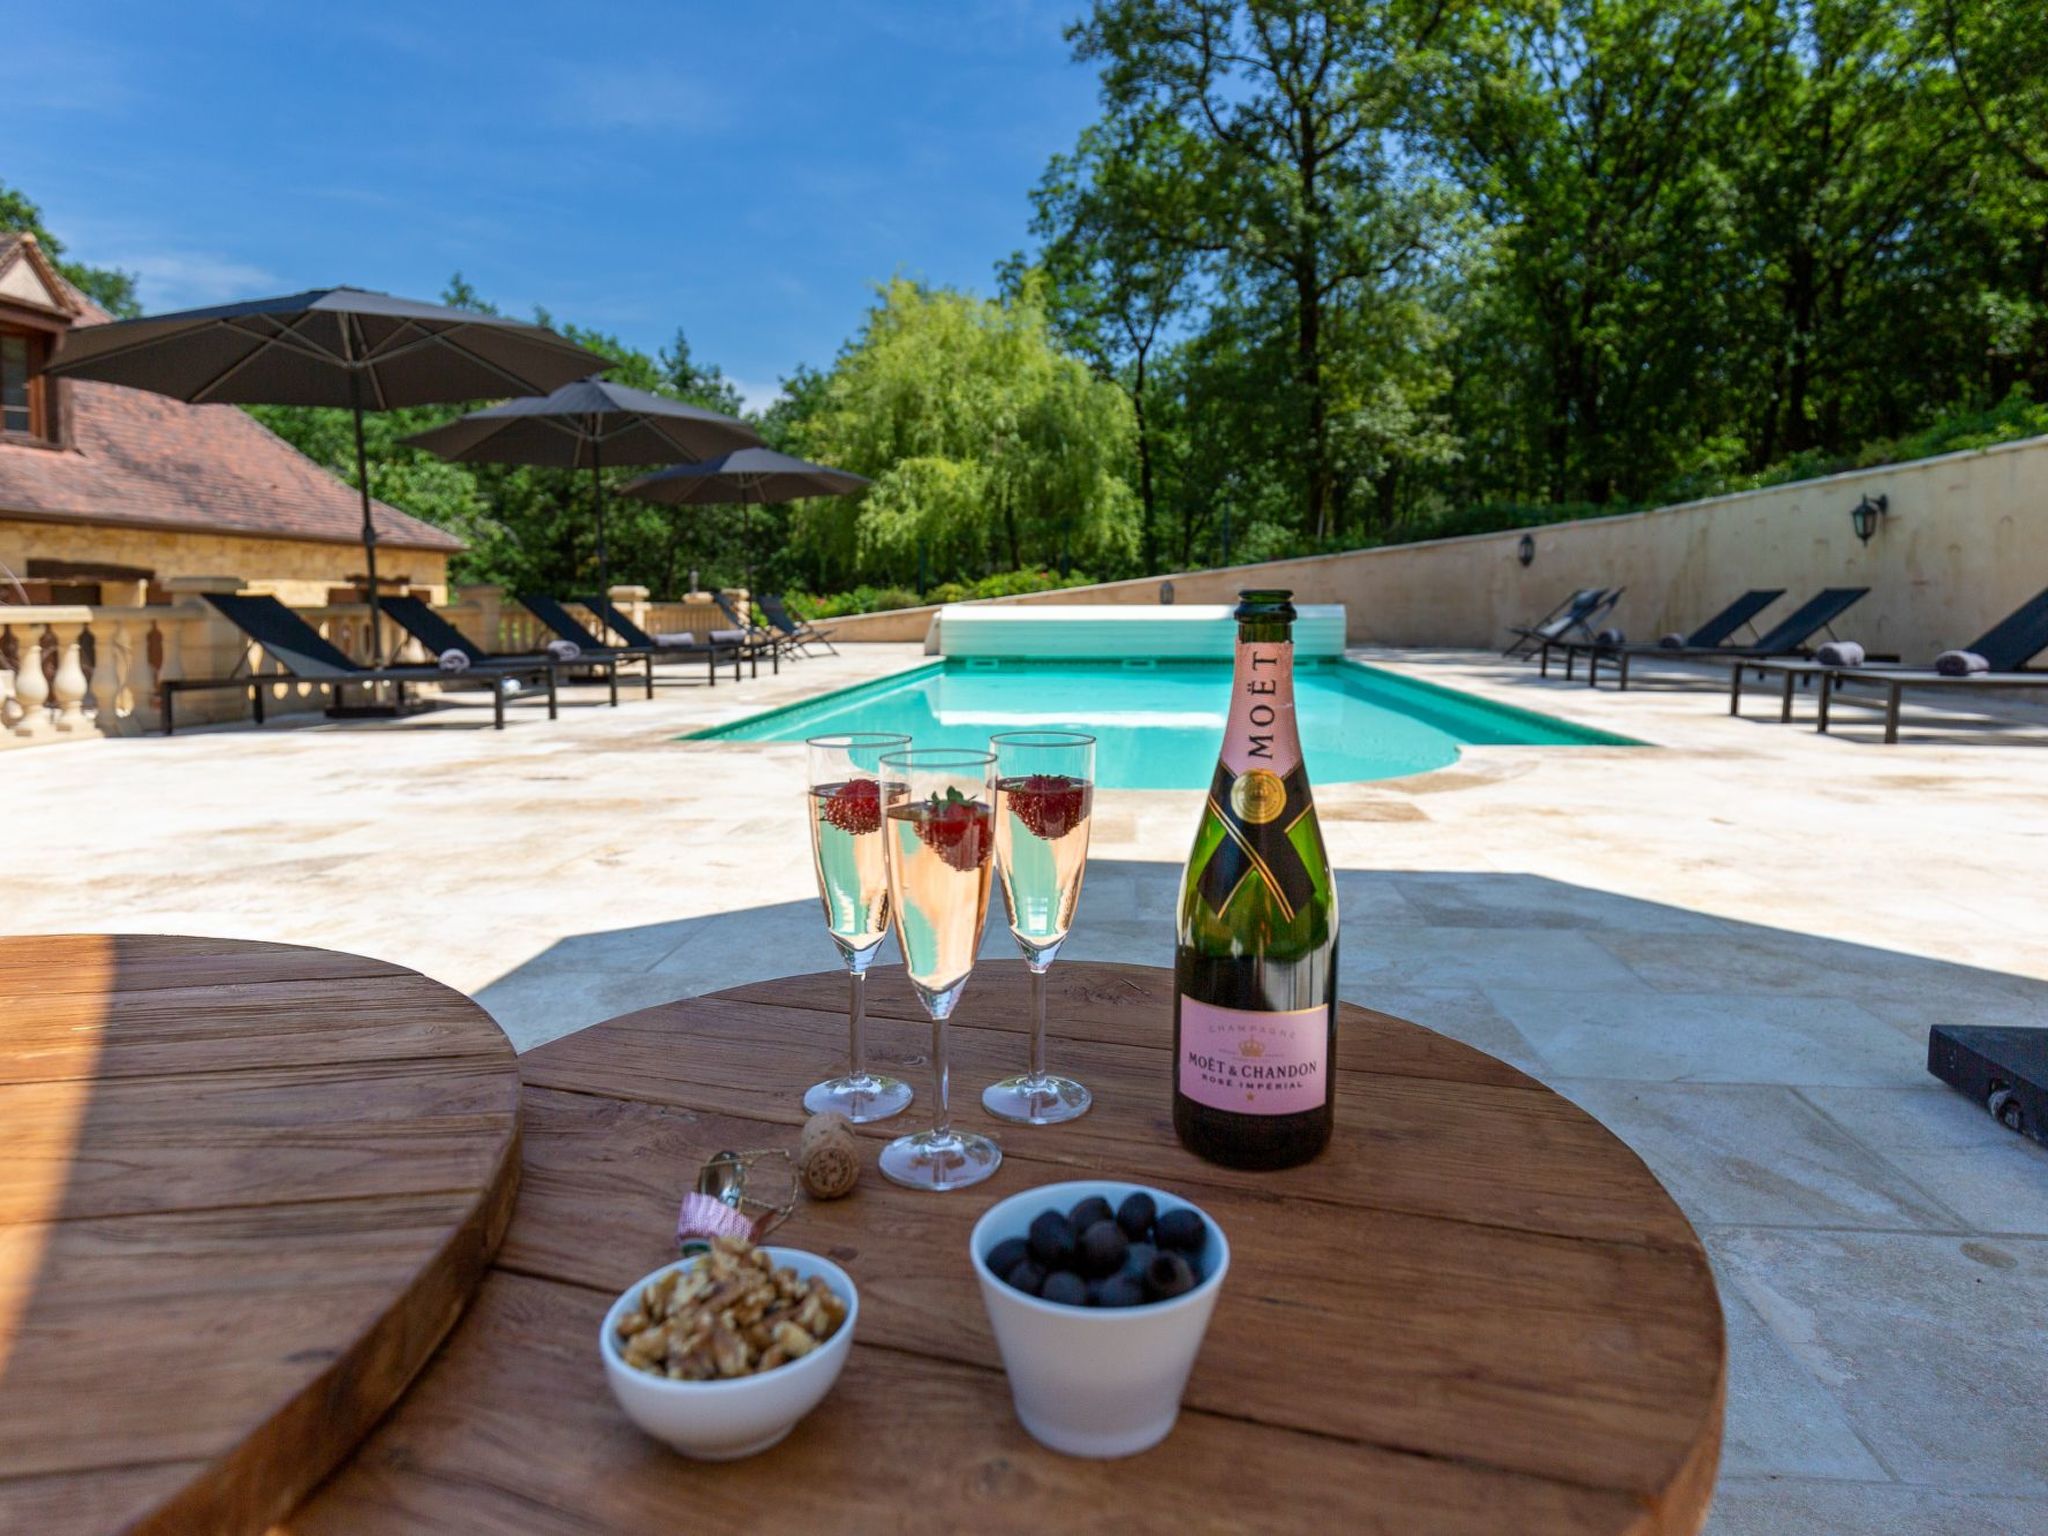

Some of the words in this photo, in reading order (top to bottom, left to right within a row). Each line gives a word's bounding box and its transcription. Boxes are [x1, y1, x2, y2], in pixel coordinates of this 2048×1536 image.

[1247, 651, 1278, 760] MOËT
[1228, 1065, 1238, 1076] &
[1241, 1061, 1317, 1079] CHANDON
